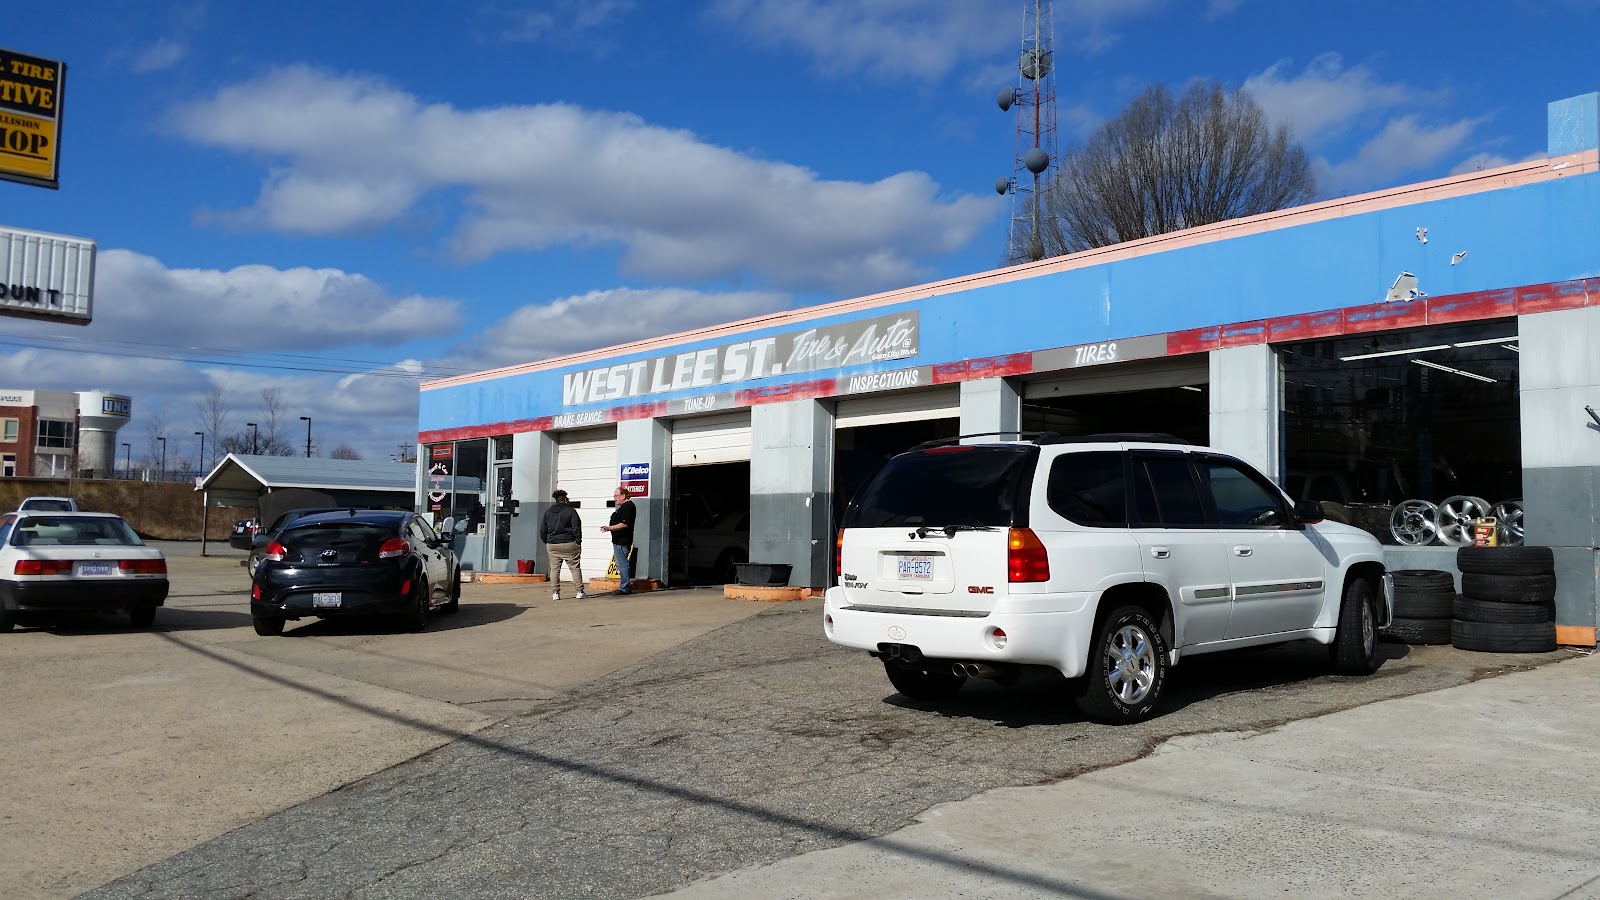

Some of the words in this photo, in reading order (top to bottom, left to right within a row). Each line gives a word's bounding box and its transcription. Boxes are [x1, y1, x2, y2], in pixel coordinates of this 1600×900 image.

[11, 60, 54, 81] TIRE
[562, 360, 647, 405] WEST
[650, 348, 718, 393] LEE
[721, 337, 783, 382] ST.
[785, 328, 832, 367] Tire
[823, 336, 849, 361] &
[841, 318, 916, 366] Auto
[1075, 342, 1117, 365] TIRES
[848, 369, 919, 392] INSPECTIONS
[103, 399, 131, 413] UNC
[684, 395, 716, 412] TUNE-UP
[554, 414, 575, 428] BRAKE
[575, 410, 602, 424] SERVICE
[622, 466, 649, 475] ACDelco
[967, 585, 995, 595] GMC
